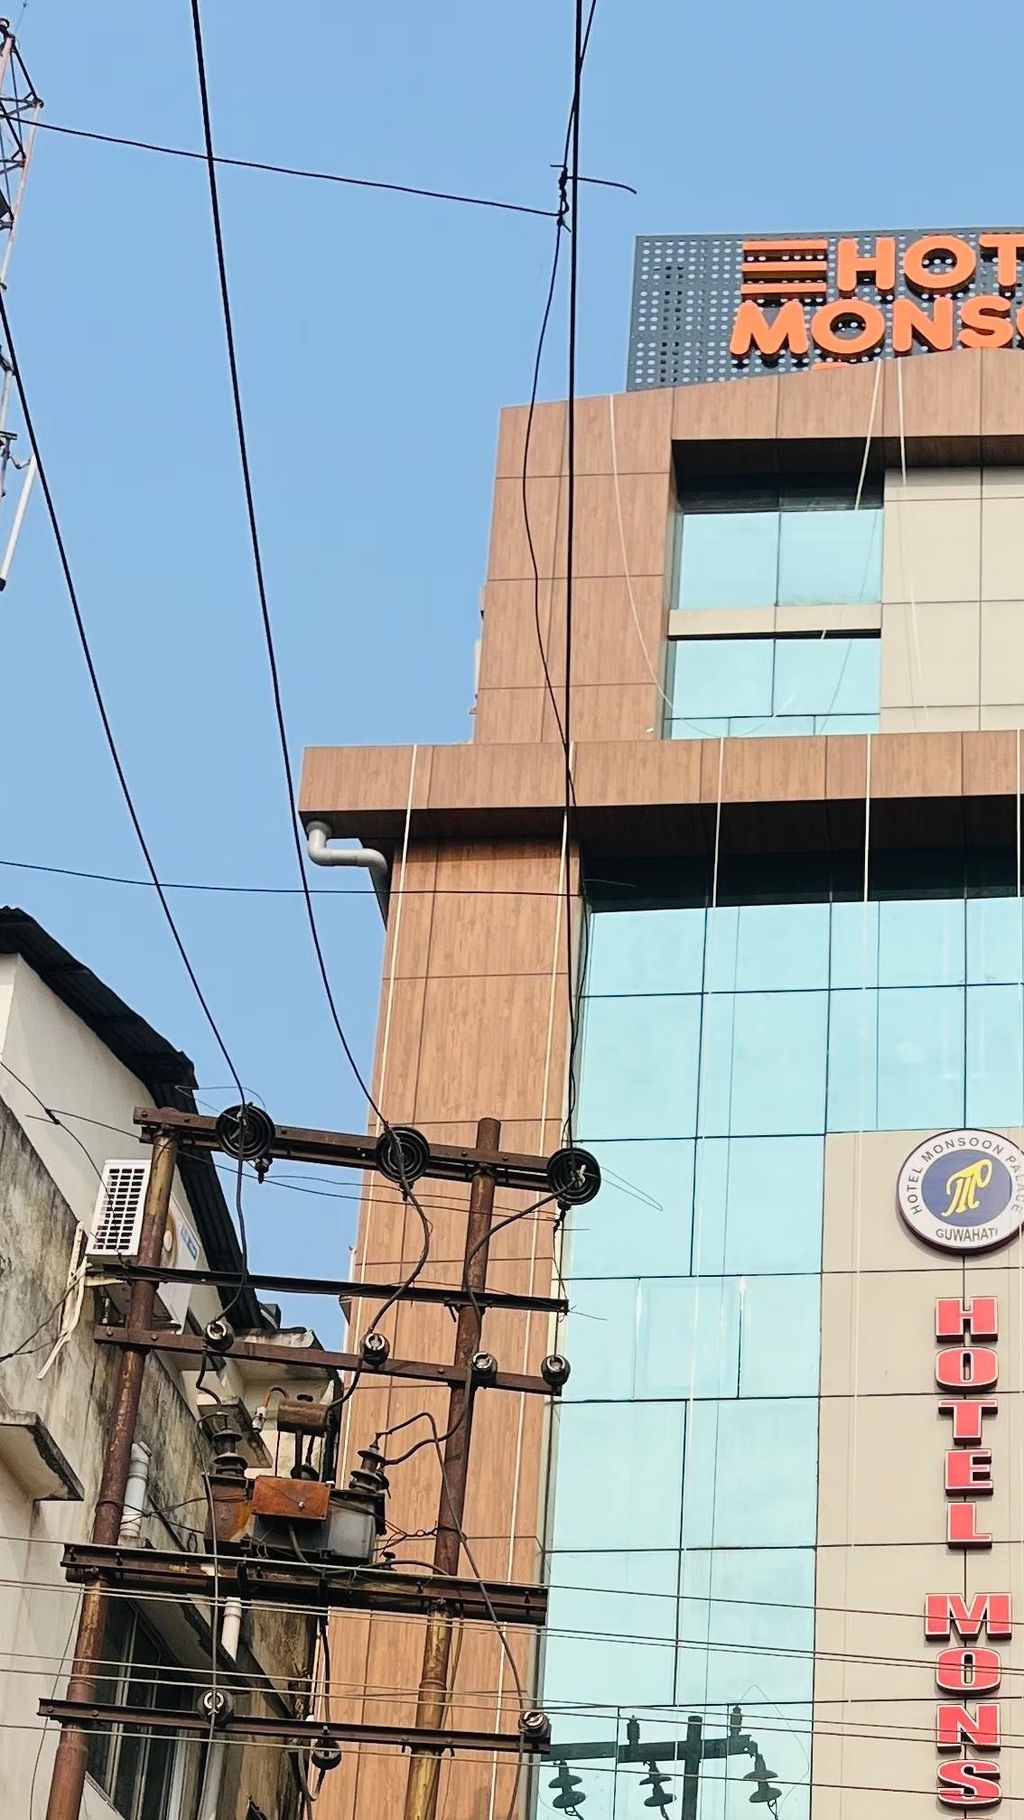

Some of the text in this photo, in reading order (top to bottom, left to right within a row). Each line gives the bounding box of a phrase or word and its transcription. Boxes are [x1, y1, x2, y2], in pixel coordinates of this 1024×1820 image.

[907, 1166, 924, 1216] HOTEL
[921, 1137, 1004, 1163] MONSOON
[935, 1227, 999, 1242] GUWAHATI
[935, 1295, 999, 1549] HOTEL
